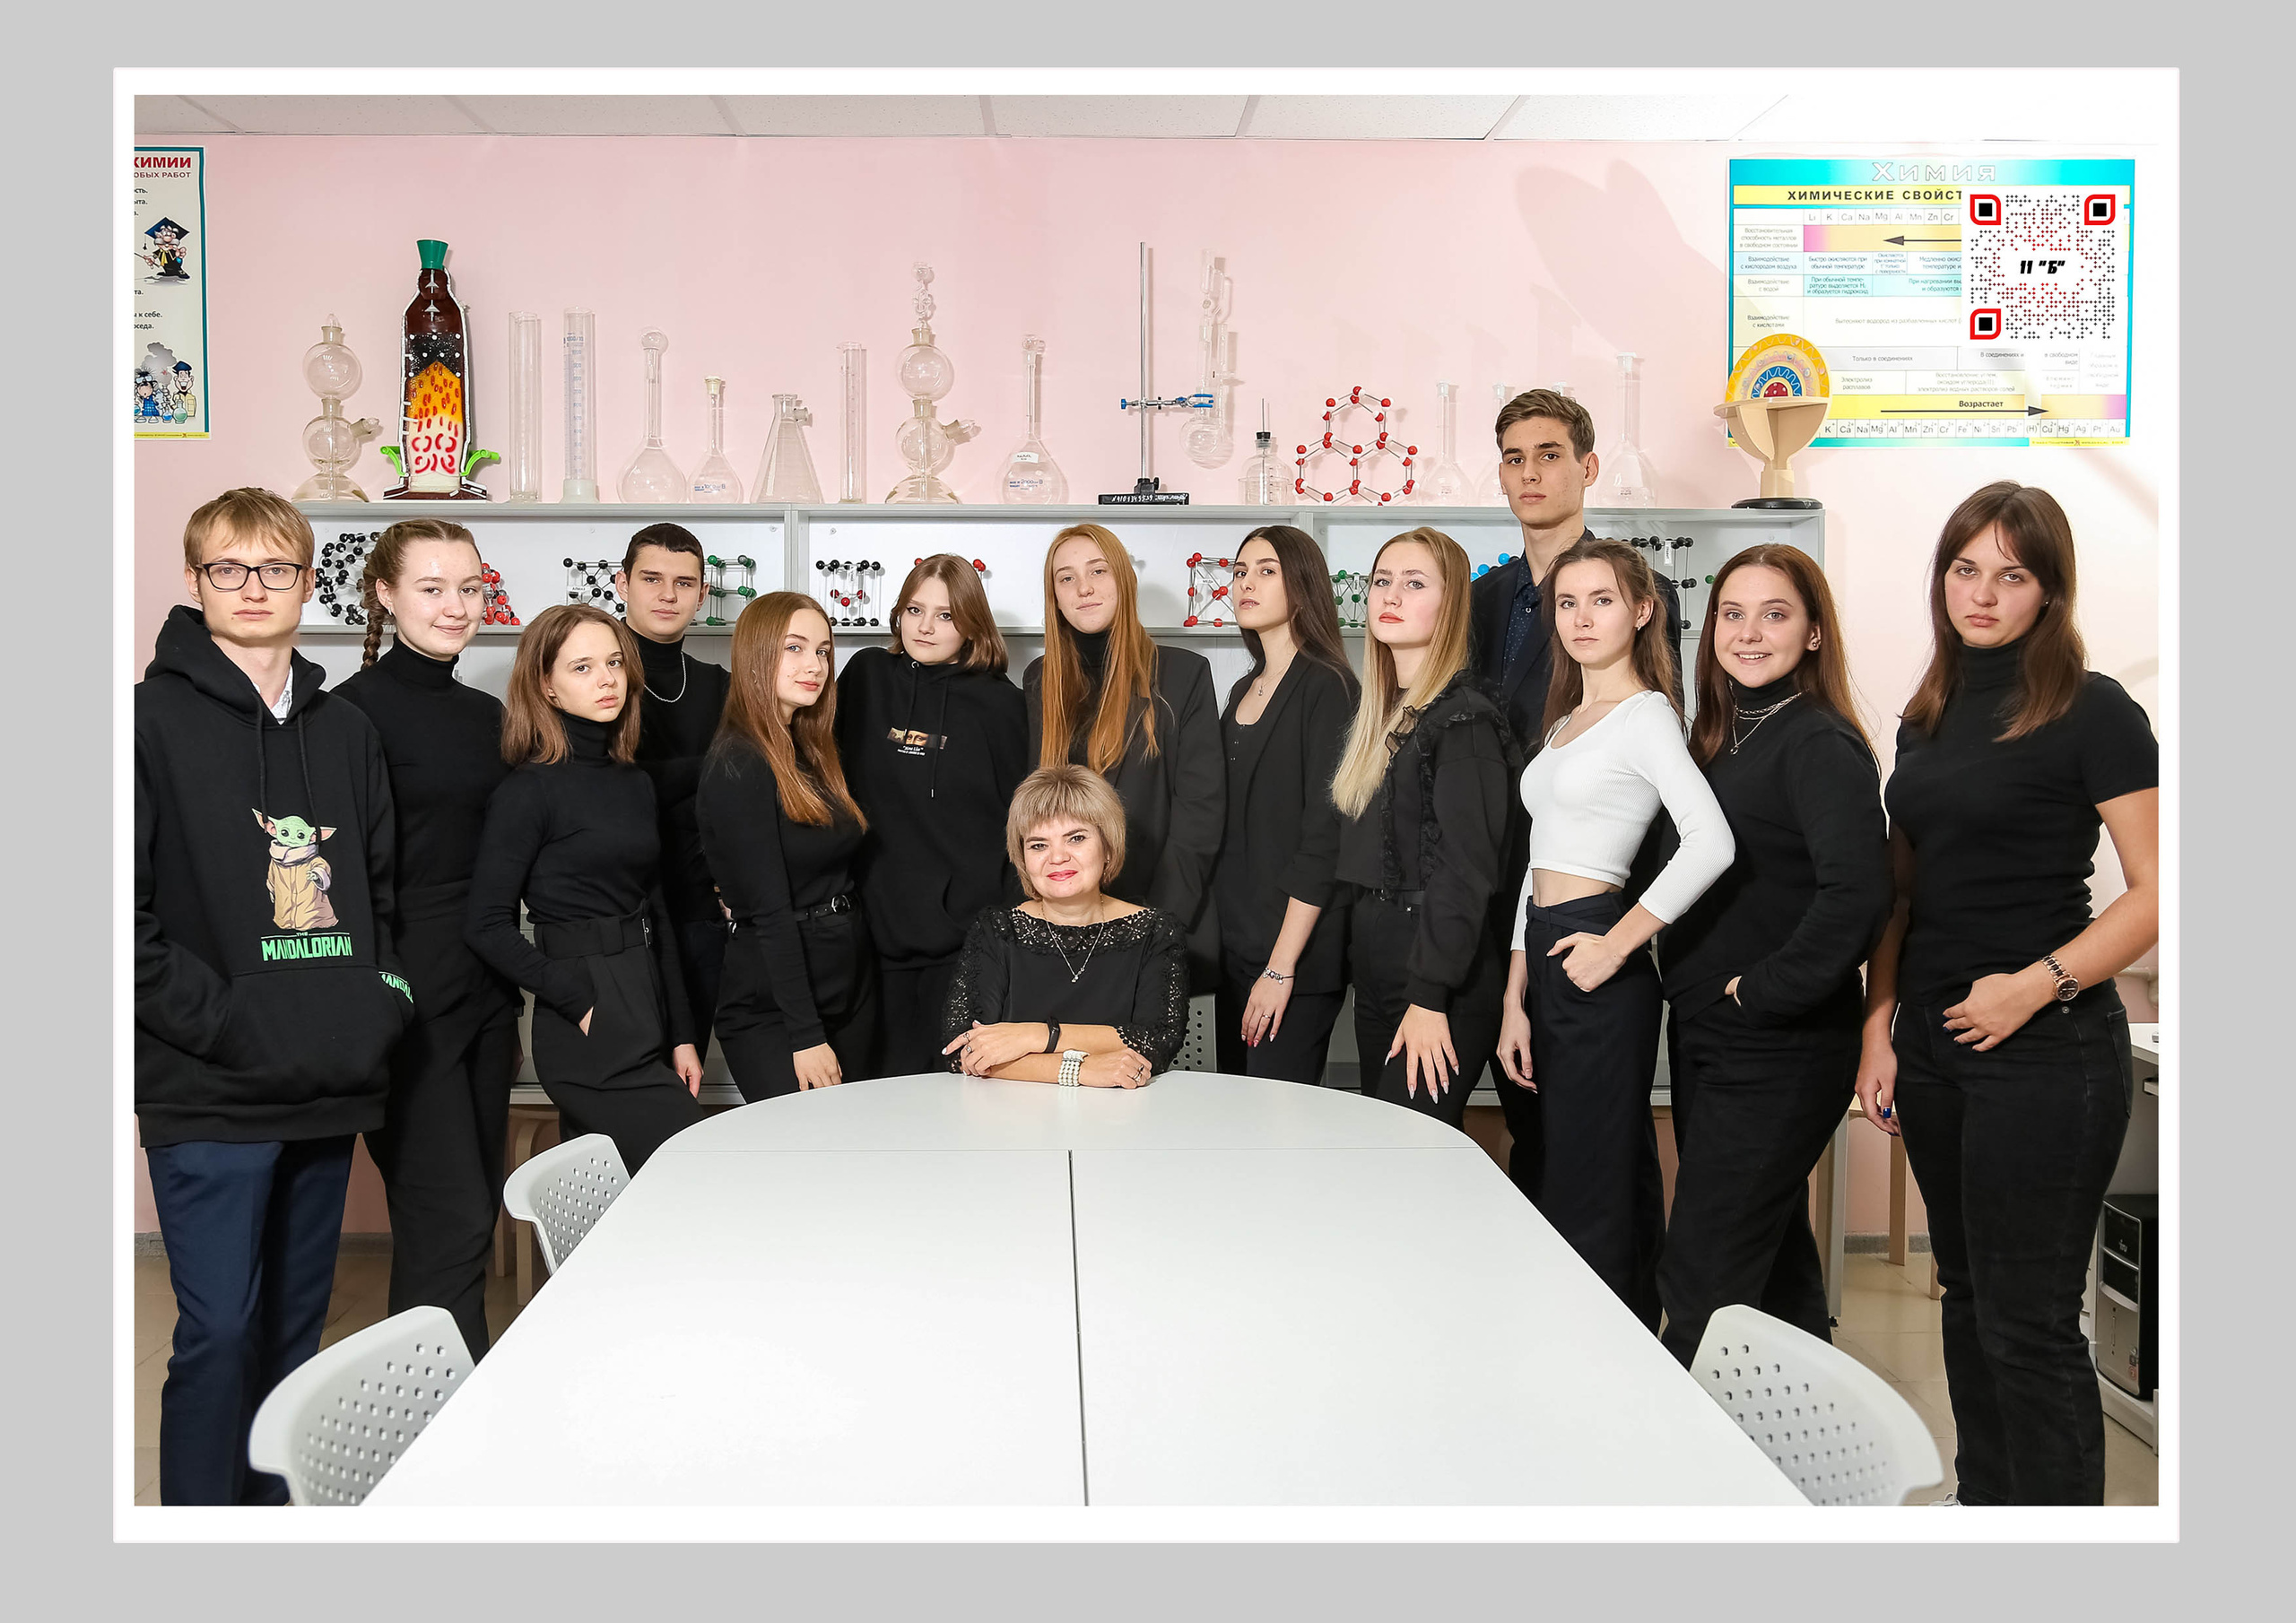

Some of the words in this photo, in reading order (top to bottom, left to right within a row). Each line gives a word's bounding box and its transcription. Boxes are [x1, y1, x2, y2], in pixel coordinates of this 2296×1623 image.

[1788, 191, 1894, 200] ХИМИЧЕСКИЕ
[1903, 188, 1961, 200] СВОЙСТ
[1876, 213, 1888, 221] Mg
[261, 936, 353, 961] MANDALORIAN
